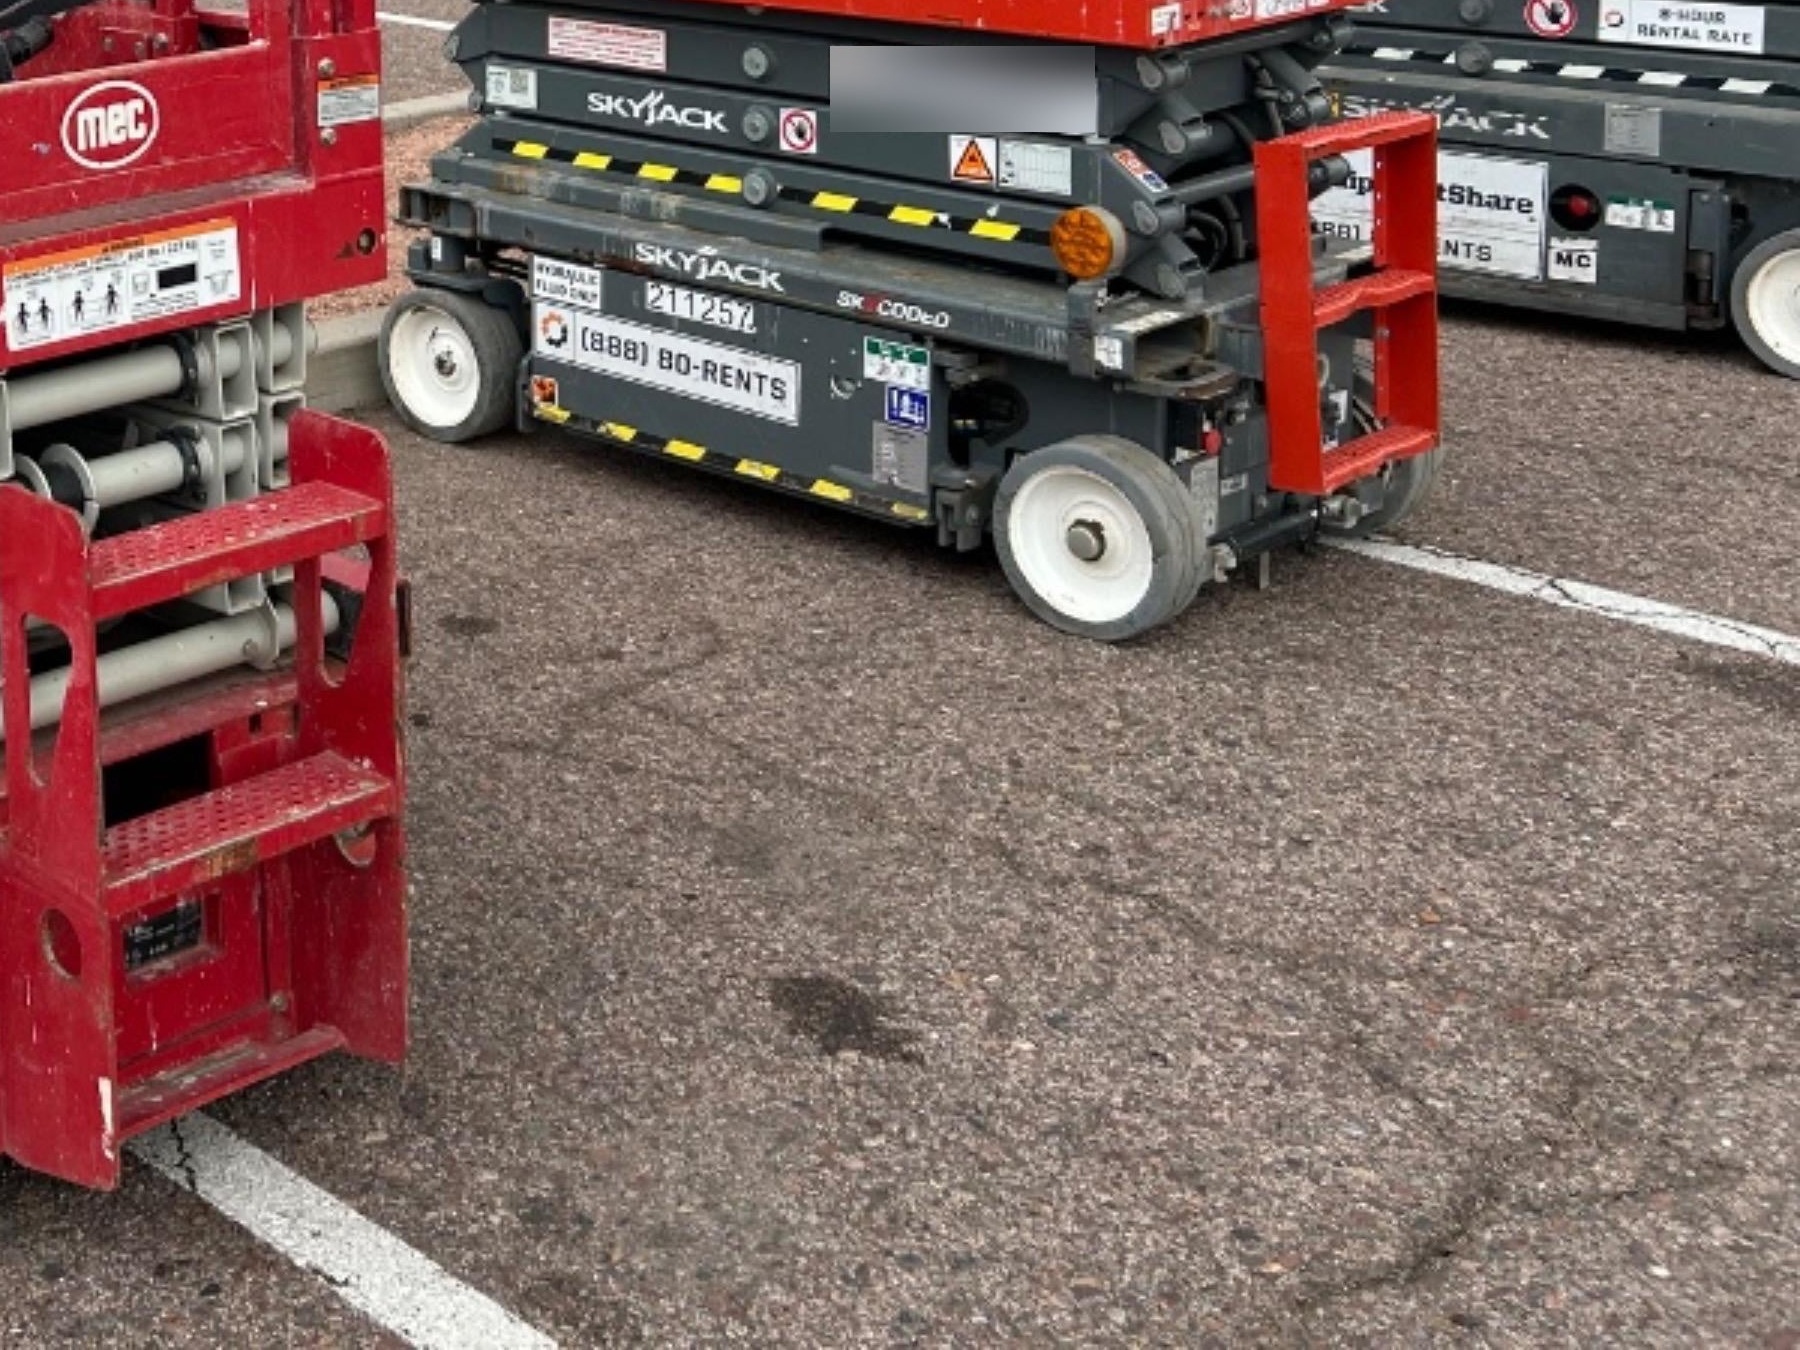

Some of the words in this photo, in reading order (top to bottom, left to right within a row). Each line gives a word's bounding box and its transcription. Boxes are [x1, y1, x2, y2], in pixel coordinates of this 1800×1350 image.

[1637, 22, 1701, 41] RENTAL
[1706, 28, 1753, 46] RATE
[586, 89, 729, 134] SKYJACK
[633, 241, 787, 296] SKYJACK
[1555, 250, 1593, 269] MC
